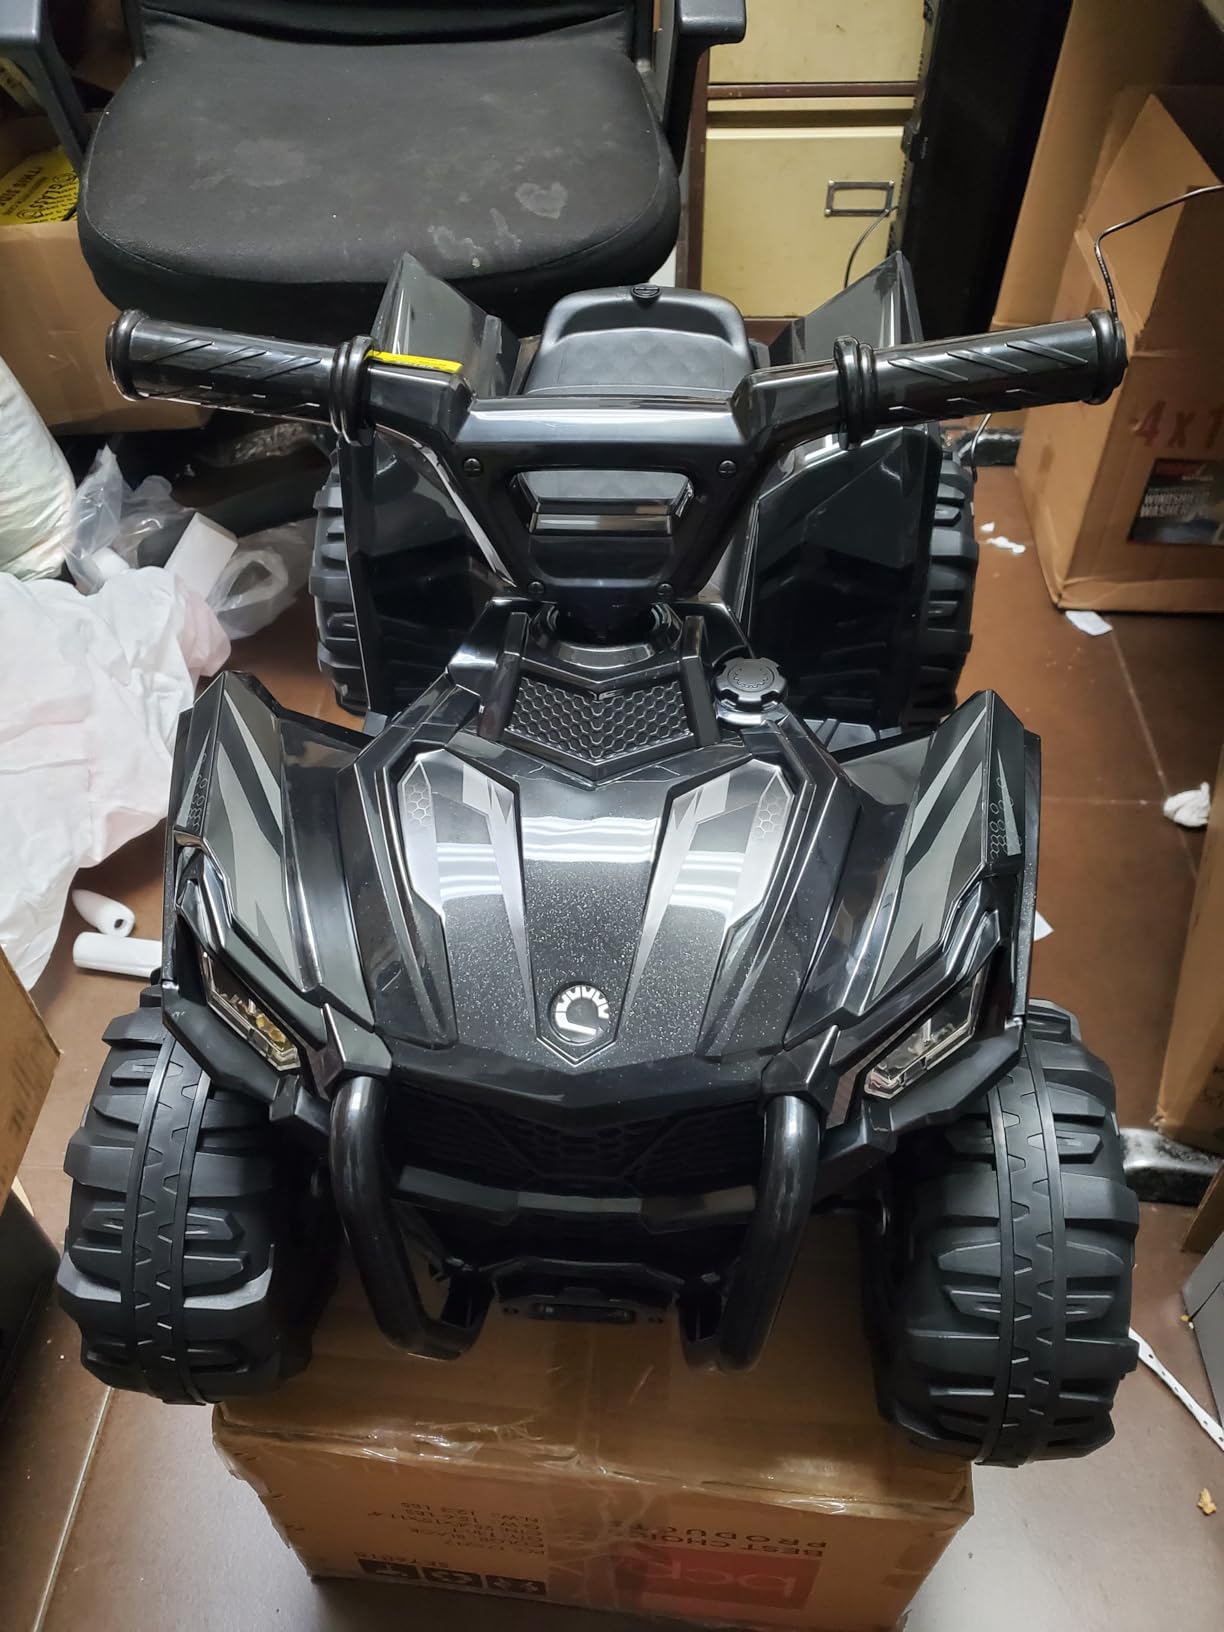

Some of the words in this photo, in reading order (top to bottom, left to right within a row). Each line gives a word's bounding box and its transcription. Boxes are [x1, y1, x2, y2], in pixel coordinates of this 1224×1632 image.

[29, 184, 62, 208] GLASS
[1136, 400, 1166, 448] 4
[740, 1543, 823, 1557] BEST
